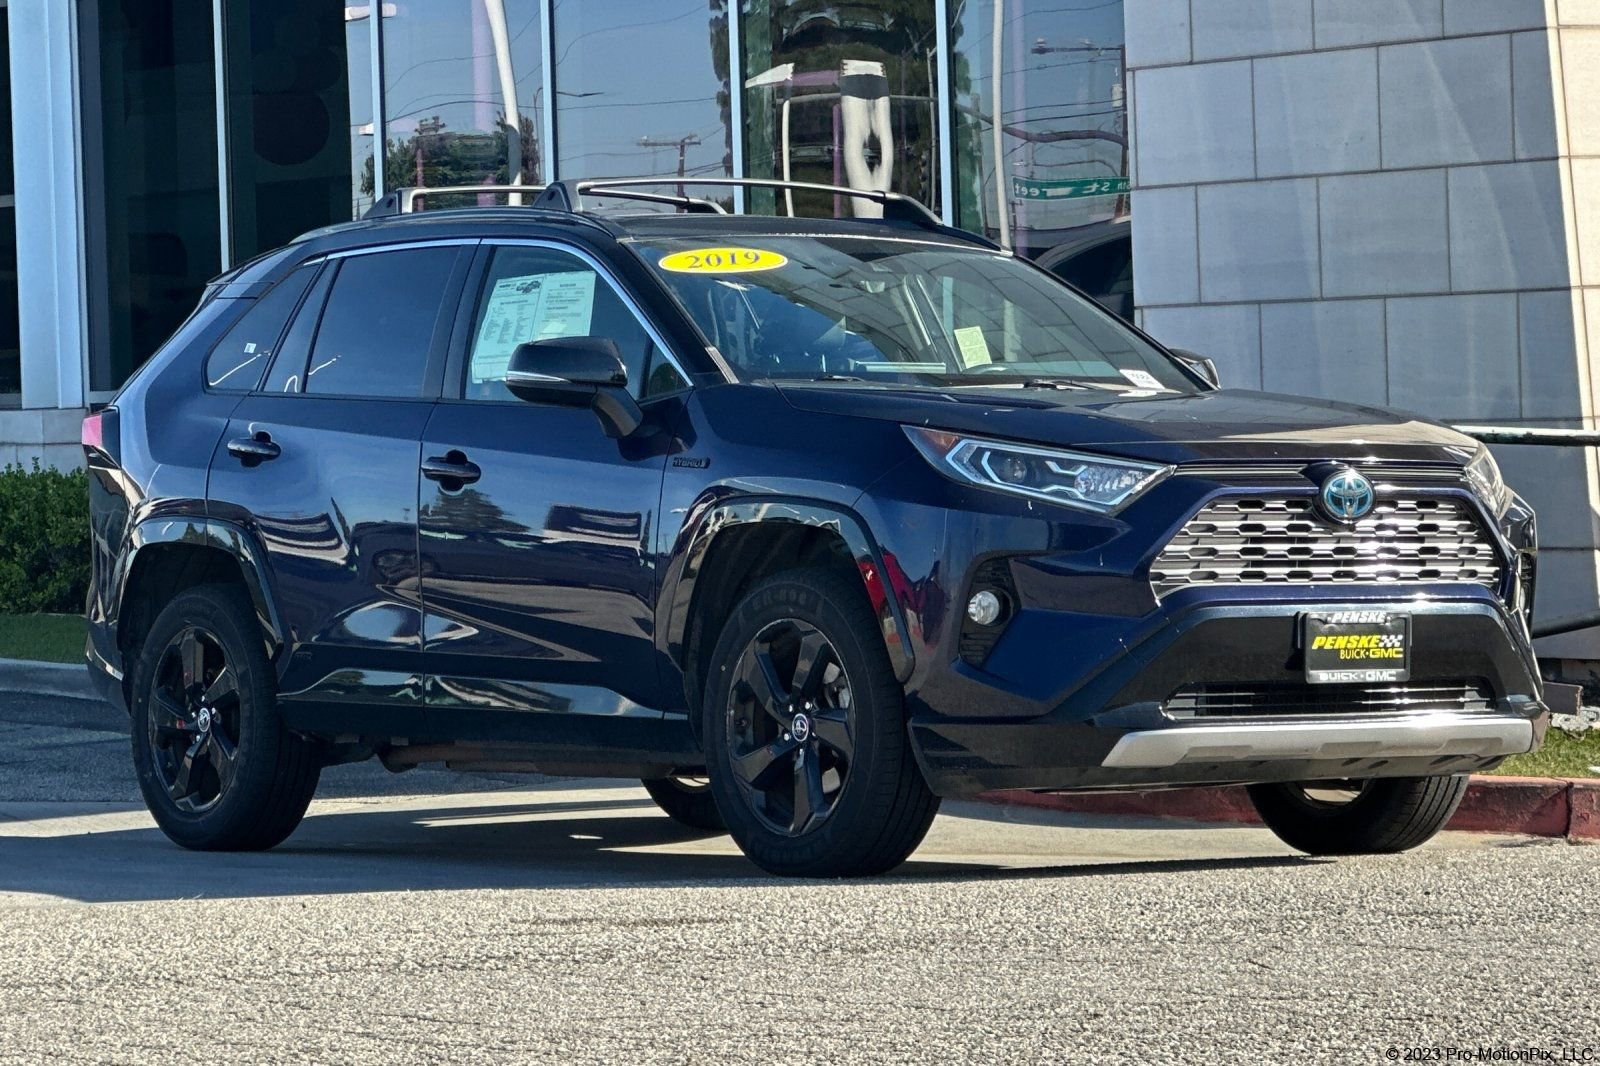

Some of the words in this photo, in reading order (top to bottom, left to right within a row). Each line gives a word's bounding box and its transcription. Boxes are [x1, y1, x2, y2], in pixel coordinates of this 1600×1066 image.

[685, 251, 760, 269] 2019
[1331, 611, 1387, 623] PENSKE
[1312, 635, 1380, 649] PENSKE
[1320, 672, 1358, 681] BUICK
[1366, 671, 1397, 681] GMC
